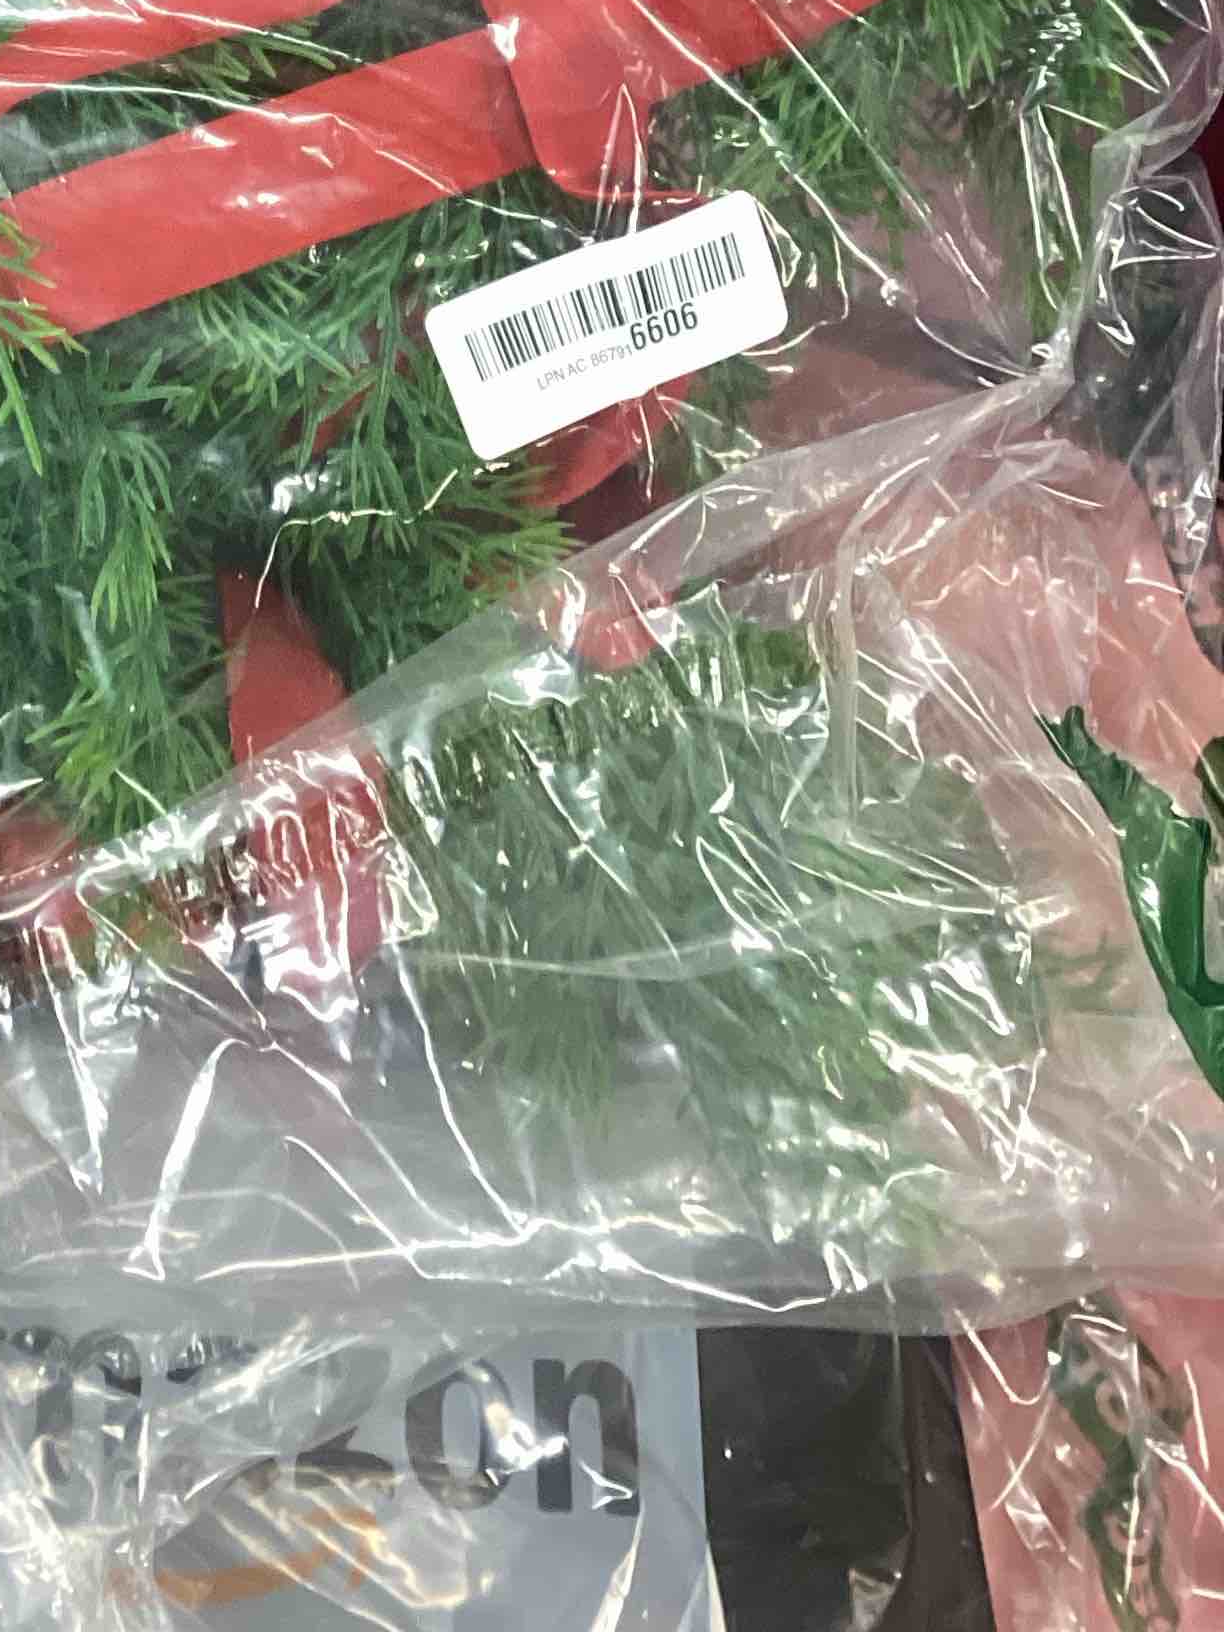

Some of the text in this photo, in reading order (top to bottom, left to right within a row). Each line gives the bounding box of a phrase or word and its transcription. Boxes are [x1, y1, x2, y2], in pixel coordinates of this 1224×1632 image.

[536, 368, 566, 391] LPN
[567, 357, 587, 377] AC
[630, 302, 699, 351] 6606
